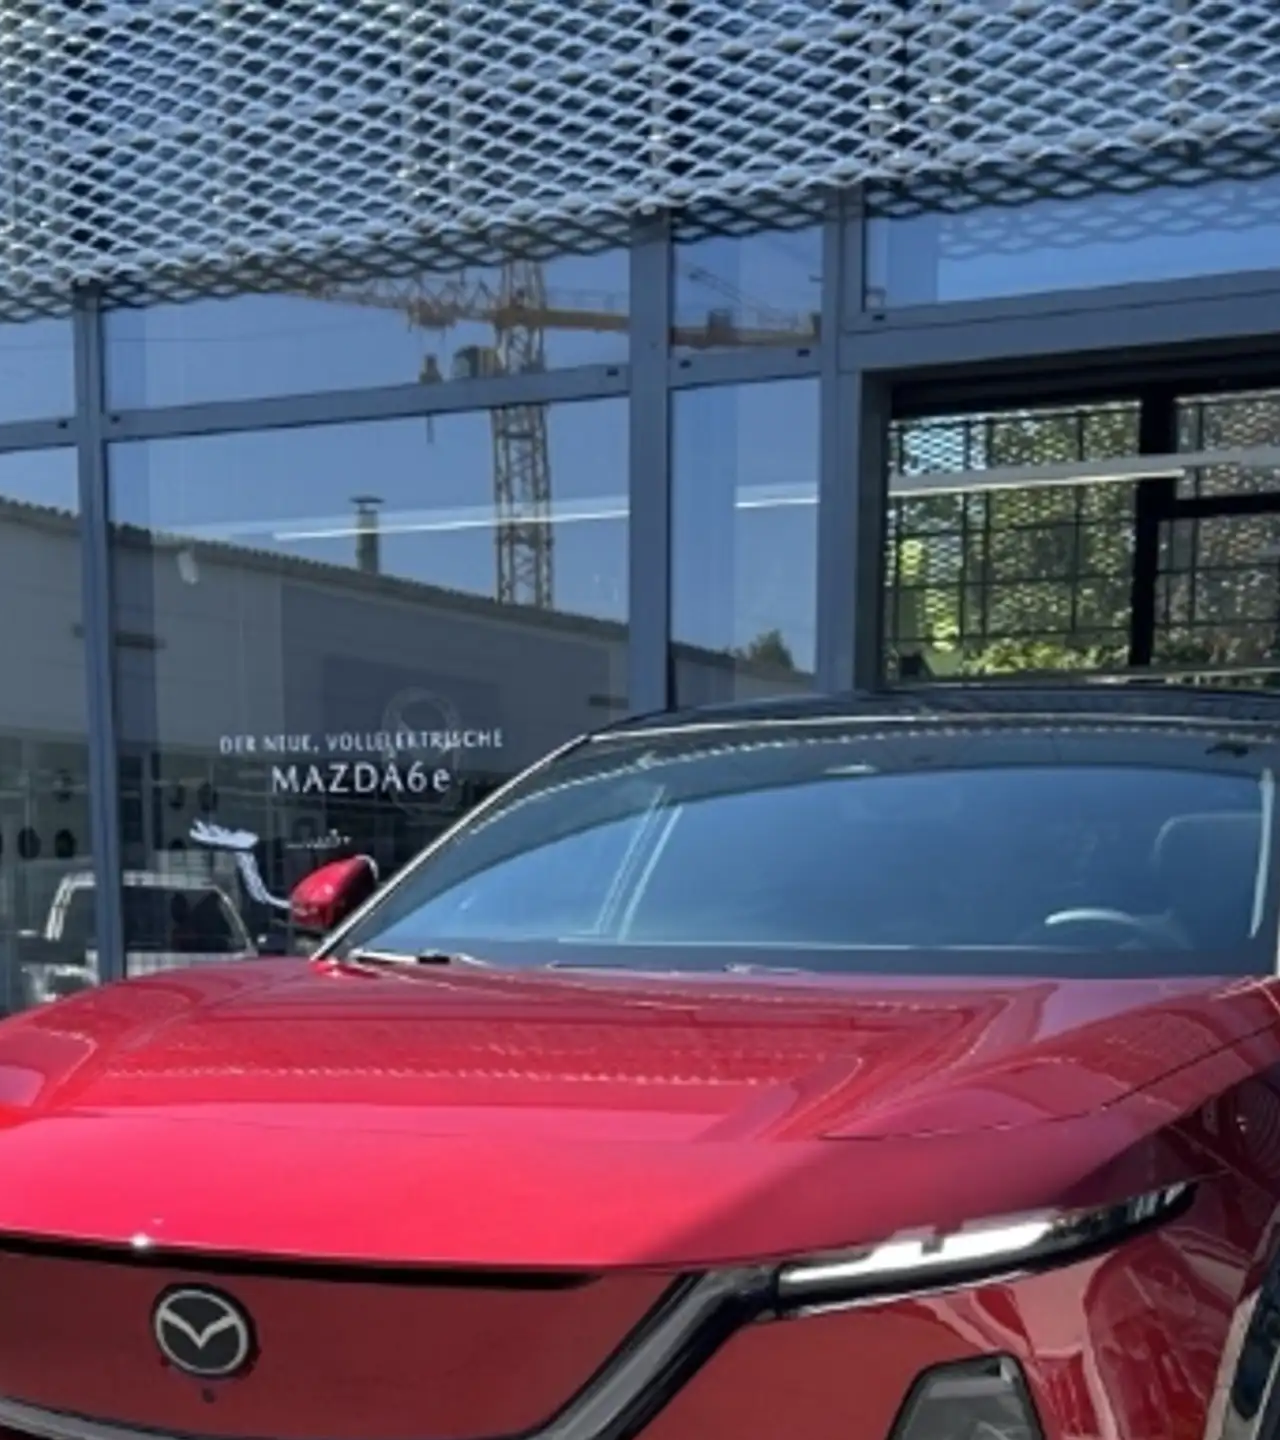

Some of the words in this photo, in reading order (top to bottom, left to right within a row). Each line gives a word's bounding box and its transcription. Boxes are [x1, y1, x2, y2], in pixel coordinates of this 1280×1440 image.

[220, 734, 256, 754] DER
[325, 728, 504, 753] VOLLELEKTRISCHE
[271, 759, 451, 794] MAZDA6e
